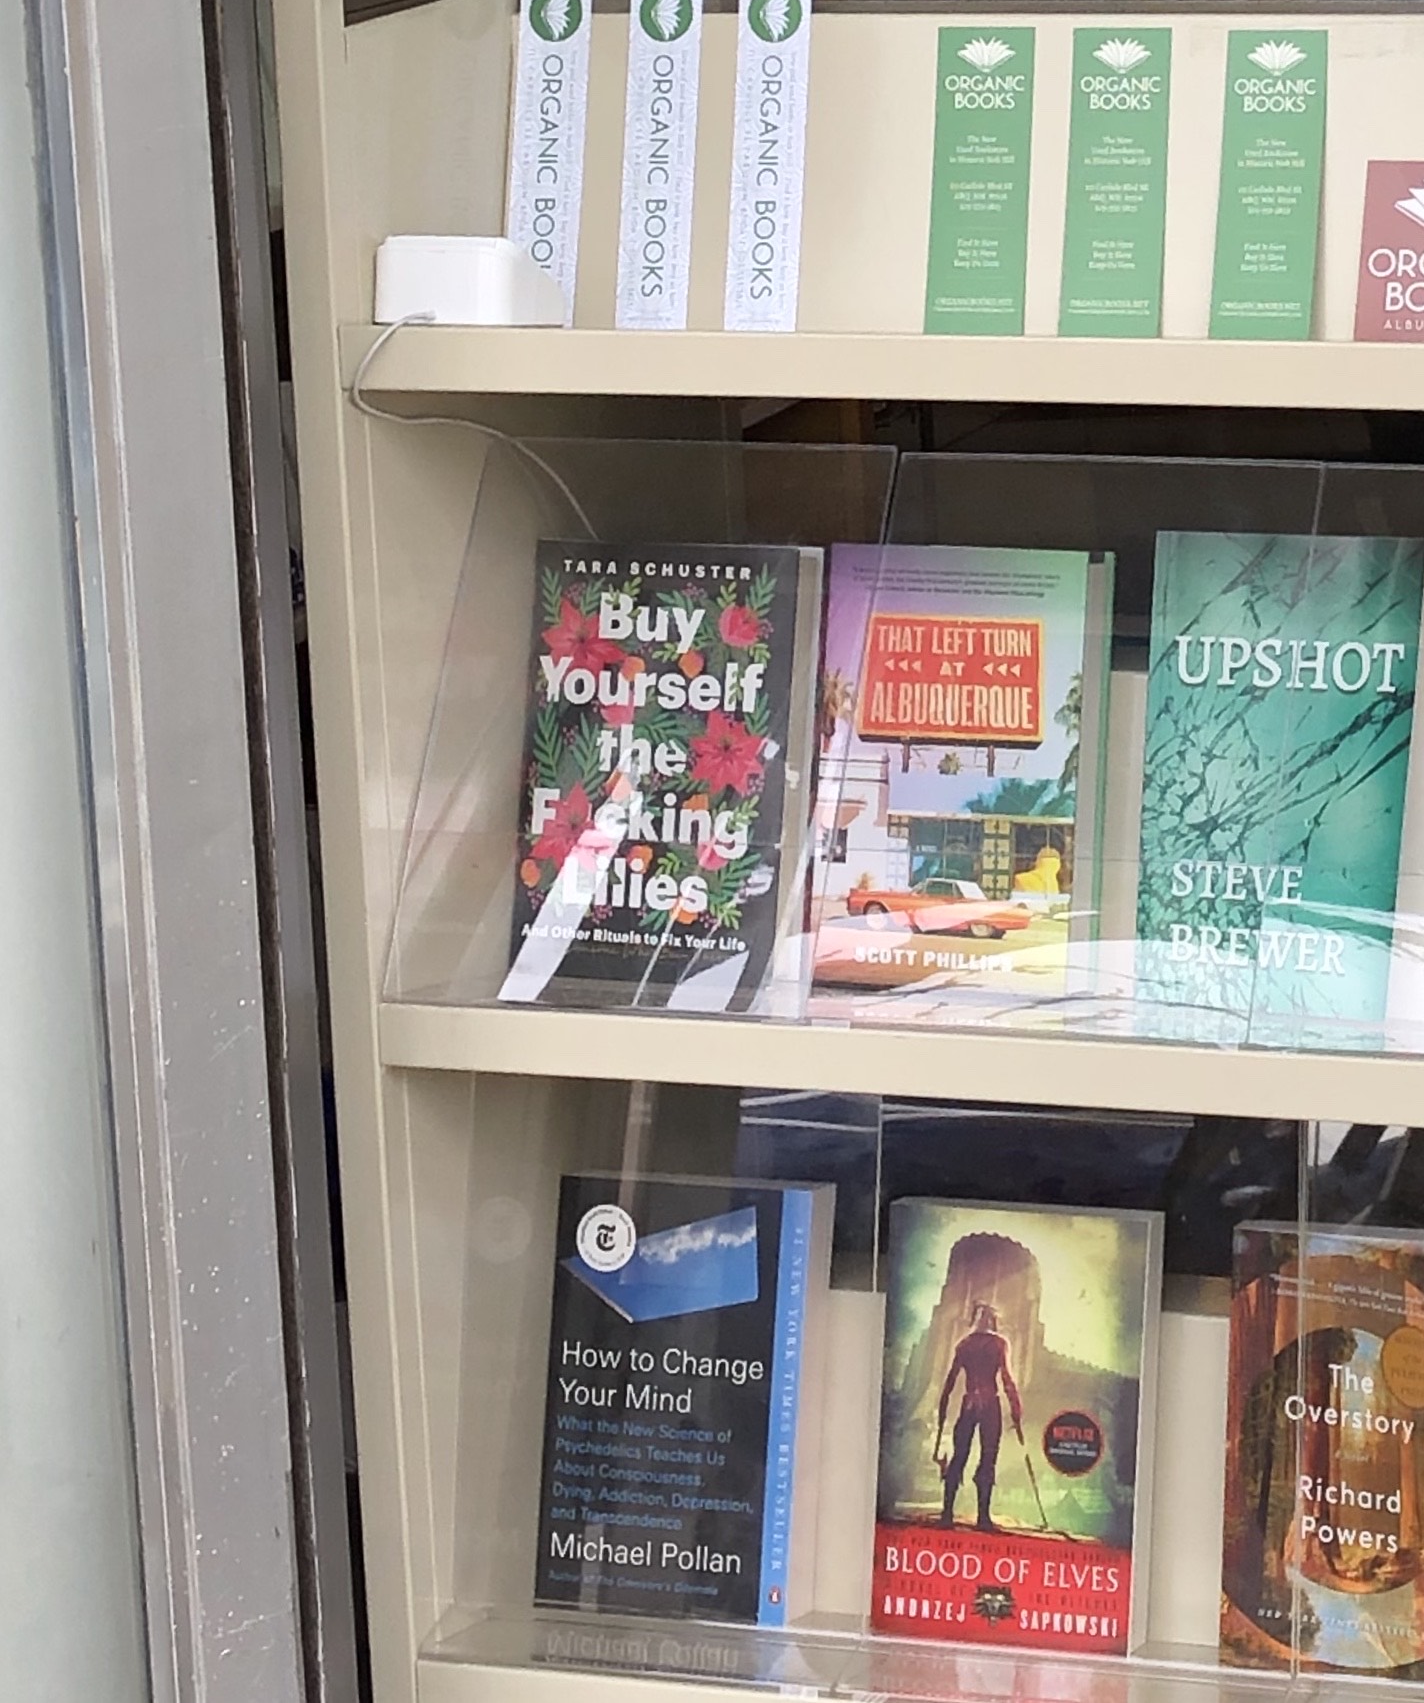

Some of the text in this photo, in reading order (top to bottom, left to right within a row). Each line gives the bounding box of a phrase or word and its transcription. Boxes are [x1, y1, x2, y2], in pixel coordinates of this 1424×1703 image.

[944, 74, 1025, 91] ORGANIC
[954, 92, 1015, 109] BOOKS
[1080, 76, 1161, 92] ORGANIC
[1090, 93, 1151, 110] BOOKS
[1234, 78, 1316, 95] ORGANIC
[537, 54, 564, 184] ORGANIC
[647, 54, 674, 185] ORGANIC
[756, 55, 783, 187] ORGANIC
[1243, 95, 1306, 112] BOOKS
[531, 198, 557, 270] BOO
[641, 199, 667, 297] BOOKS
[750, 200, 777, 299] BOOKS
[564, 559, 752, 581] TARA SCHUSTER
[599, 591, 706, 654] Buy
[877, 624, 1033, 658] THAT LEFT TURN
[539, 655, 764, 713] Yourself
[939, 660, 967, 677] AT
[1175, 635, 1404, 693] UPSHOT
[870, 681, 1034, 730] ALBUQUERQUE
[596, 724, 688, 776] the
[531, 787, 748, 859] Fcking
[562, 856, 708, 914] Lilies
[1170, 858, 1304, 904] STEVE
[521, 923, 747, 952] And Other Rituals to Fix Your Life
[1168, 923, 1345, 976] BREWER
[853, 946, 1013, 973] SCOTT PHILLIPS
[562, 1340, 764, 1385] How to Change
[1328, 1363, 1374, 1394] The
[558, 1377, 692, 1414] Your Mind
[771, 1255, 803, 1572] NEW YORK TIMES BESTSELLER
[556, 1414, 732, 1444] What the New Science of
[1053, 1426, 1094, 1442] NETFLIX
[1284, 1395, 1415, 1444] Overstory
[555, 1437, 725, 1466] Psychedelics Teaches Us
[553, 1459, 705, 1488] About Consciousness,
[553, 1481, 754, 1515] Dying, Addiction, Depression,
[1299, 1475, 1402, 1514] Richard
[551, 1506, 683, 1530] and Transcendence
[1300, 1515, 1398, 1554] Powers
[550, 1531, 742, 1575] Michael Pollan
[885, 1546, 982, 1580] BLOOD
[994, 1557, 1031, 1584] OF
[1043, 1561, 1120, 1593] ELVES
[883, 1595, 967, 1623] ANDRZEJ
[1018, 1609, 1118, 1638] SAPKOWSKI
